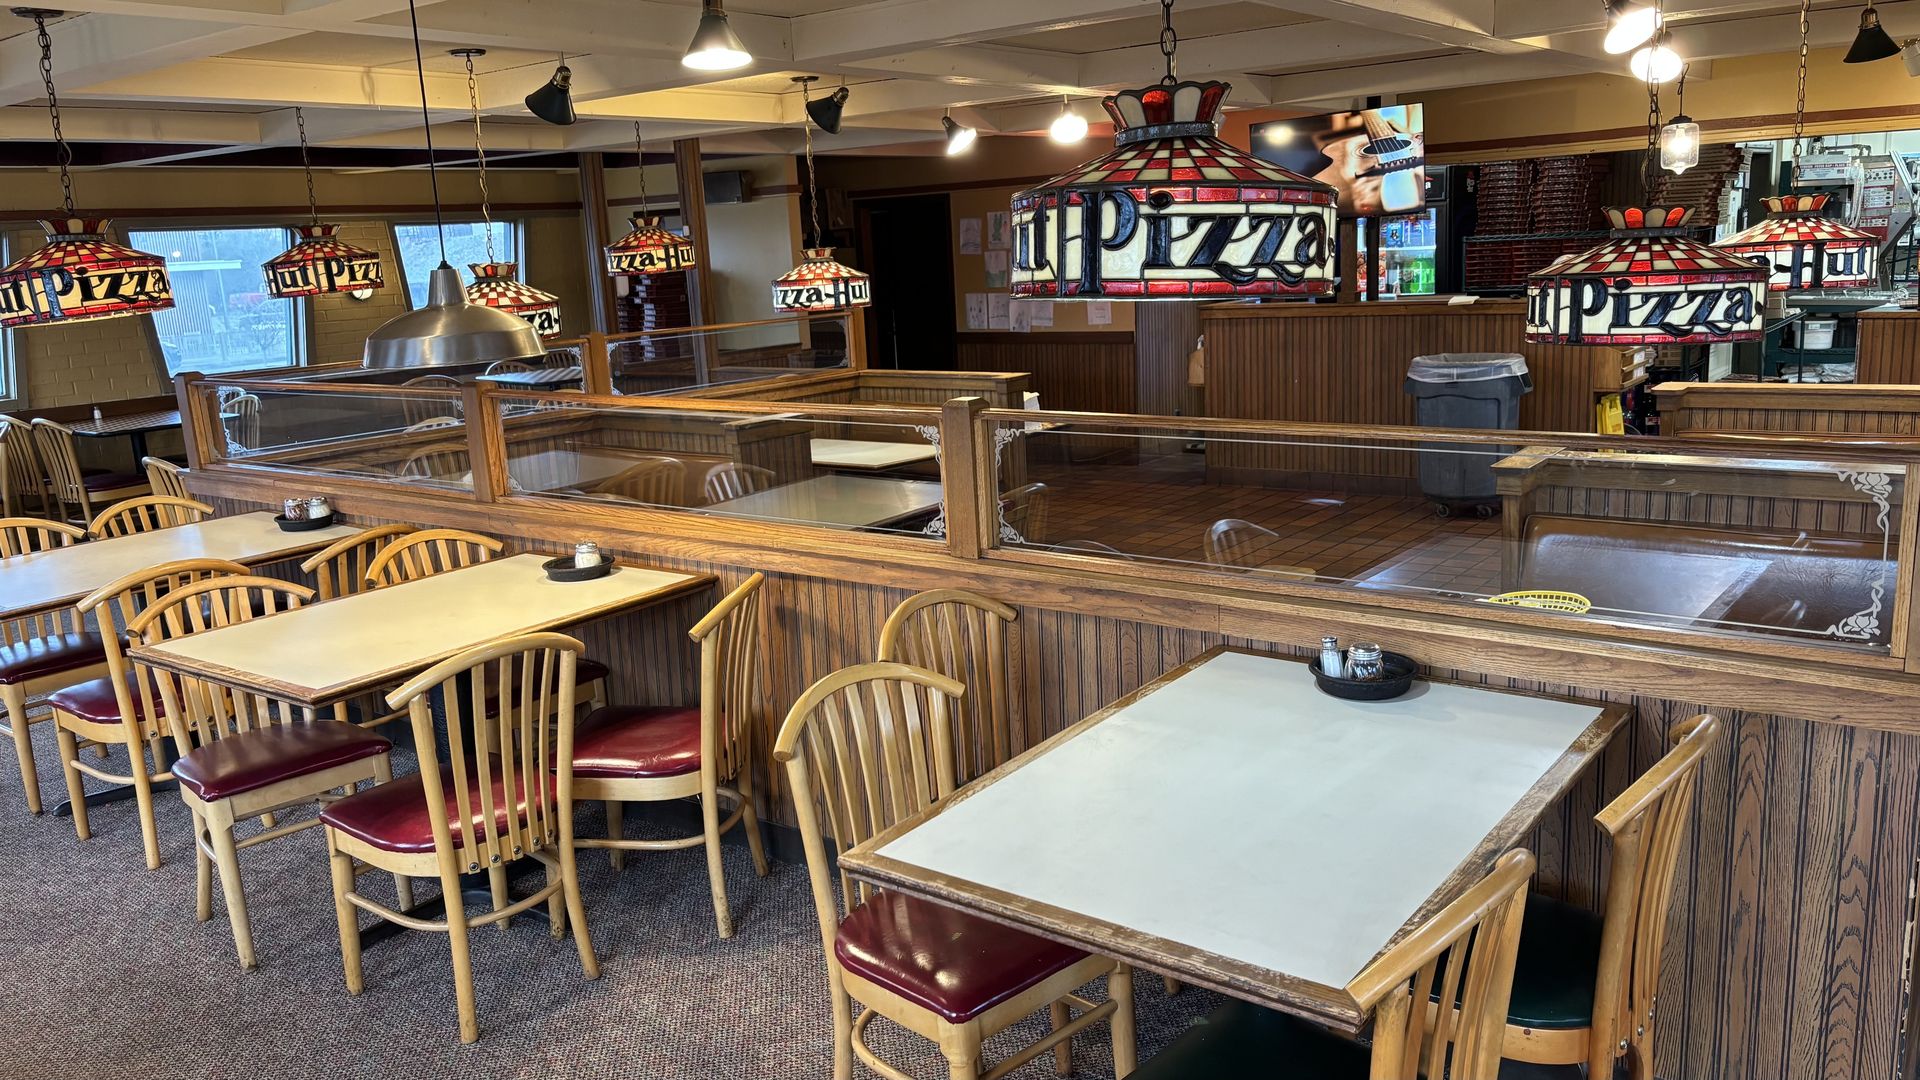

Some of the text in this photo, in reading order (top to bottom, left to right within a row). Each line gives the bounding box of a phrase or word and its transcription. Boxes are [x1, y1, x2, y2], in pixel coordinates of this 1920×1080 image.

[1079, 189, 1326, 294] Pizza
[41, 266, 170, 318] Pizza
[323, 256, 383, 292] Pizz
[1567, 278, 1754, 343] Pizza
